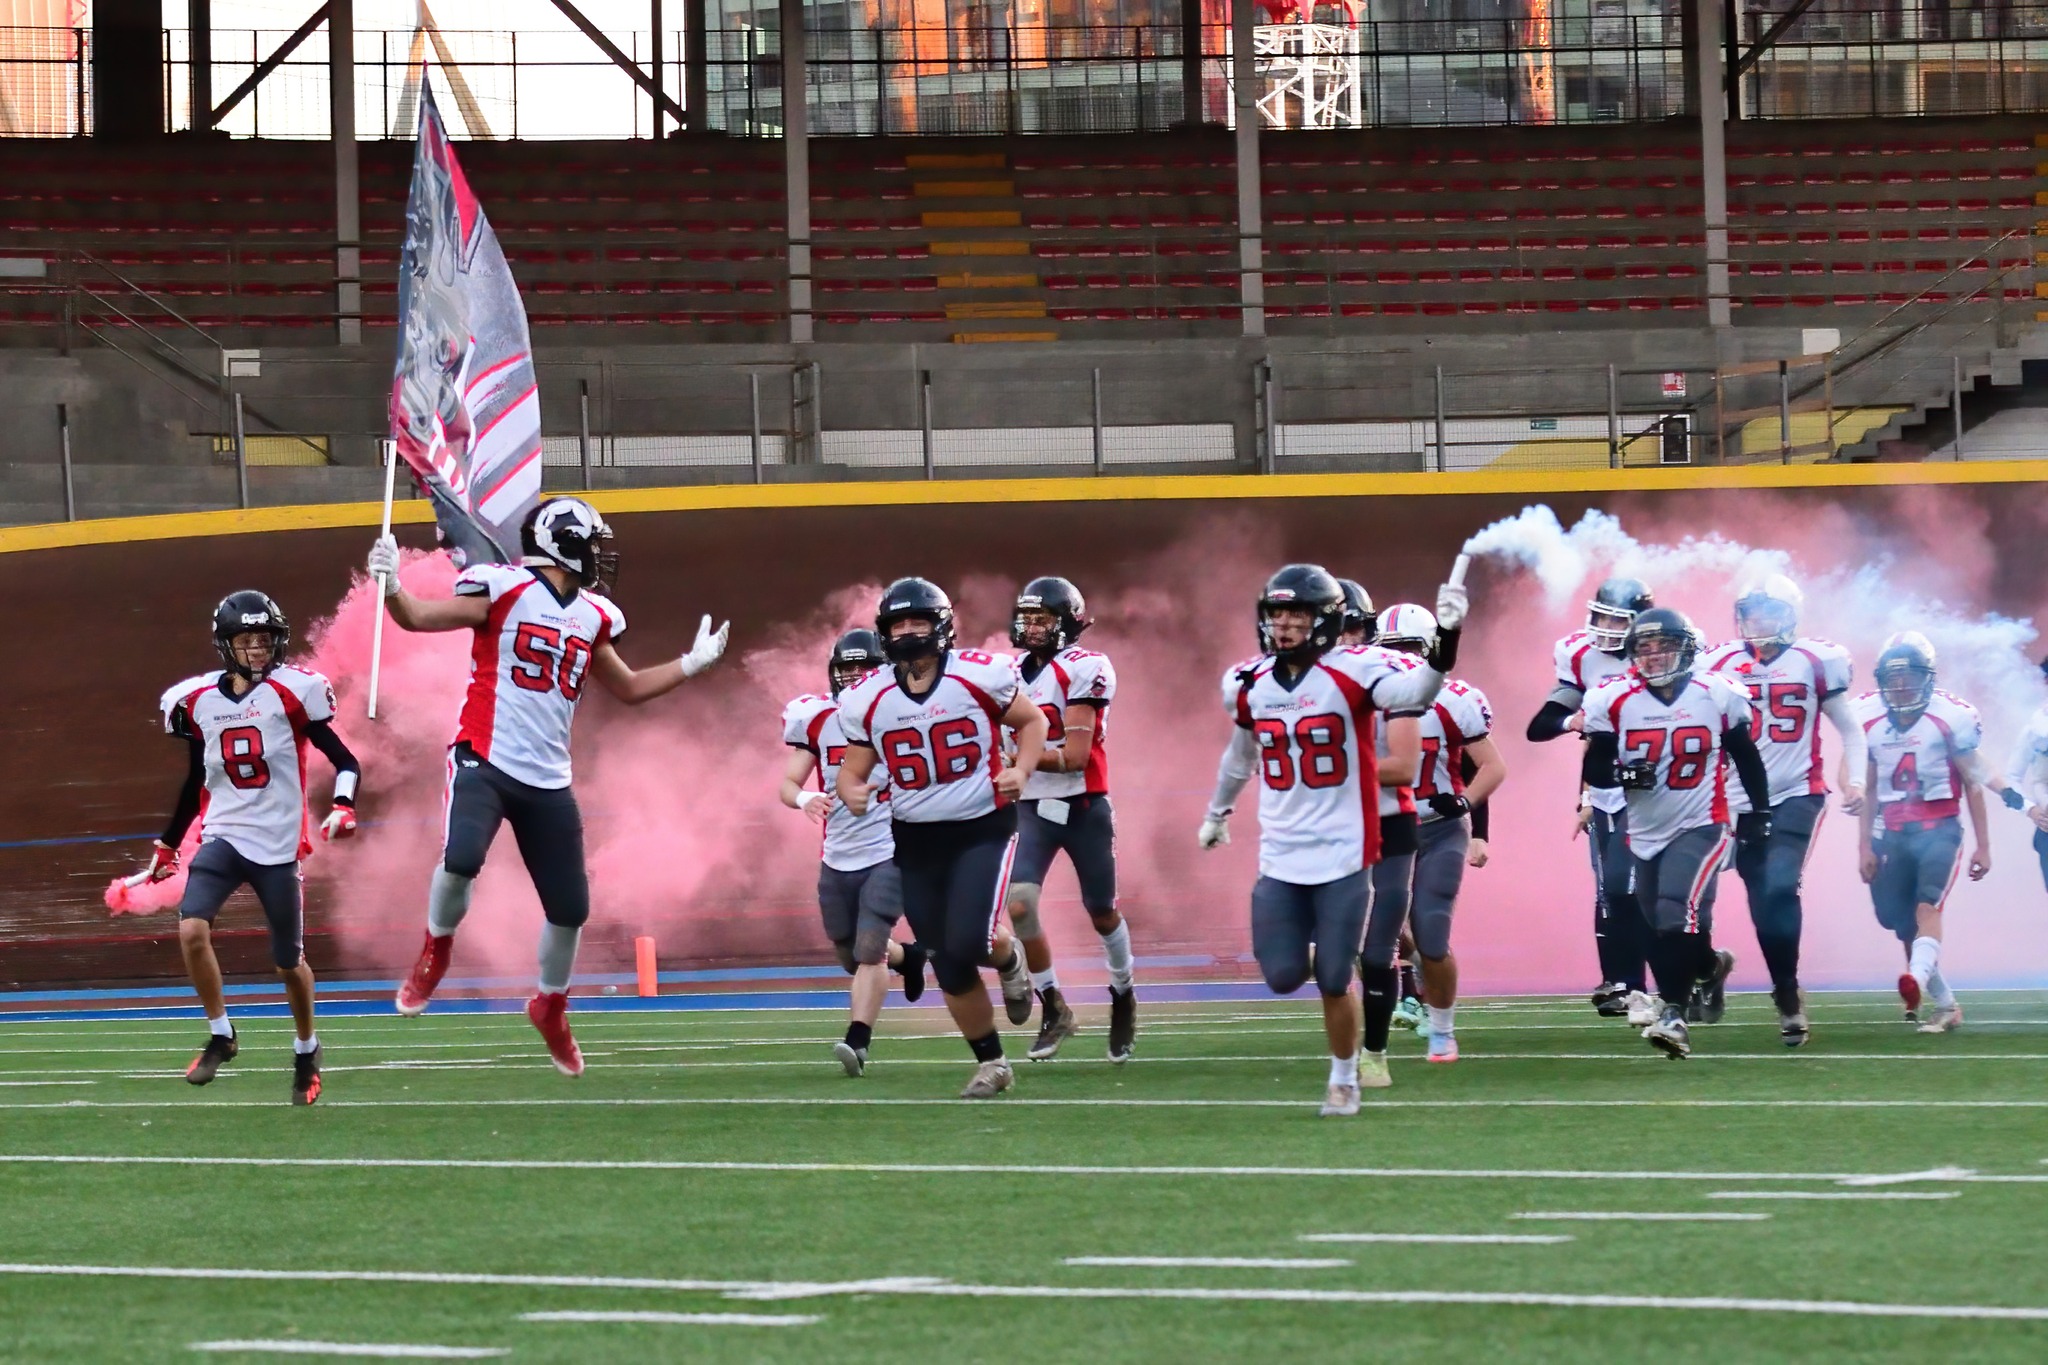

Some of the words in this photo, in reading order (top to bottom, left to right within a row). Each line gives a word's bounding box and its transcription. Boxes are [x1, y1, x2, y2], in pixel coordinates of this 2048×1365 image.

[511, 622, 591, 702] 50
[220, 725, 270, 789] 8
[882, 717, 982, 790] 66
[1254, 712, 1348, 790] 88
[1626, 725, 1712, 790] 78
[1891, 752, 1923, 798] 4
